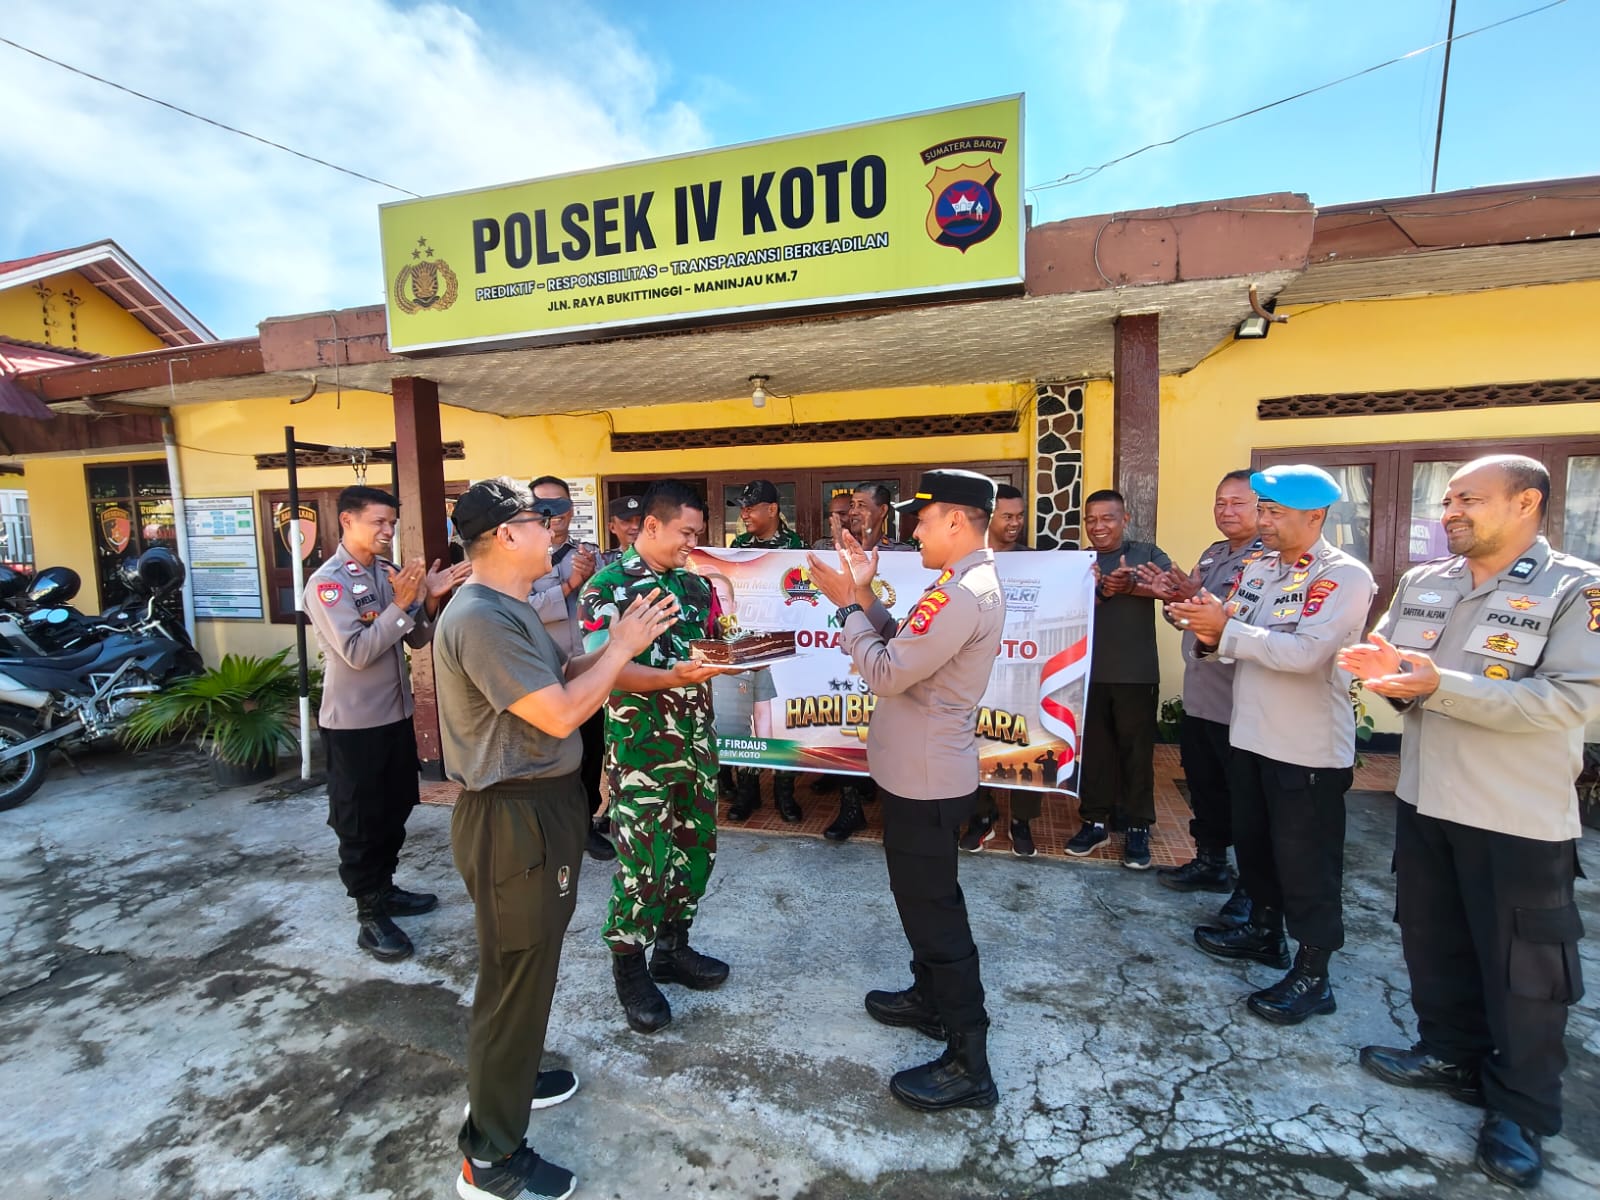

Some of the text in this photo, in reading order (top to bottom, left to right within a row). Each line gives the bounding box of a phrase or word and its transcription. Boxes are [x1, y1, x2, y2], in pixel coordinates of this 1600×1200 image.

[925, 139, 1003, 161] SUMATERA BARAT
[472, 154, 888, 274] POLSEK IV KOTO
[475, 281, 536, 301] PREDIKTIF
[547, 265, 657, 292] RESPONSIBILITAS
[671, 248, 781, 275] TRANSPARANSI
[784, 231, 889, 260] BERKEADILAN
[547, 300, 571, 312] JLN.
[573, 295, 605, 309] RAYA
[607, 285, 683, 305] BUKITTINGGI
[694, 274, 764, 294] MANINJAU
[766, 269, 798, 284] KM.7
[1273, 592, 1303, 606] POLRI
[1486, 613, 1541, 631] POLRI
[786, 694, 842, 728] HARI
[724, 739, 768, 751] FIRDAUS
[738, 750, 761, 759] KOTO
